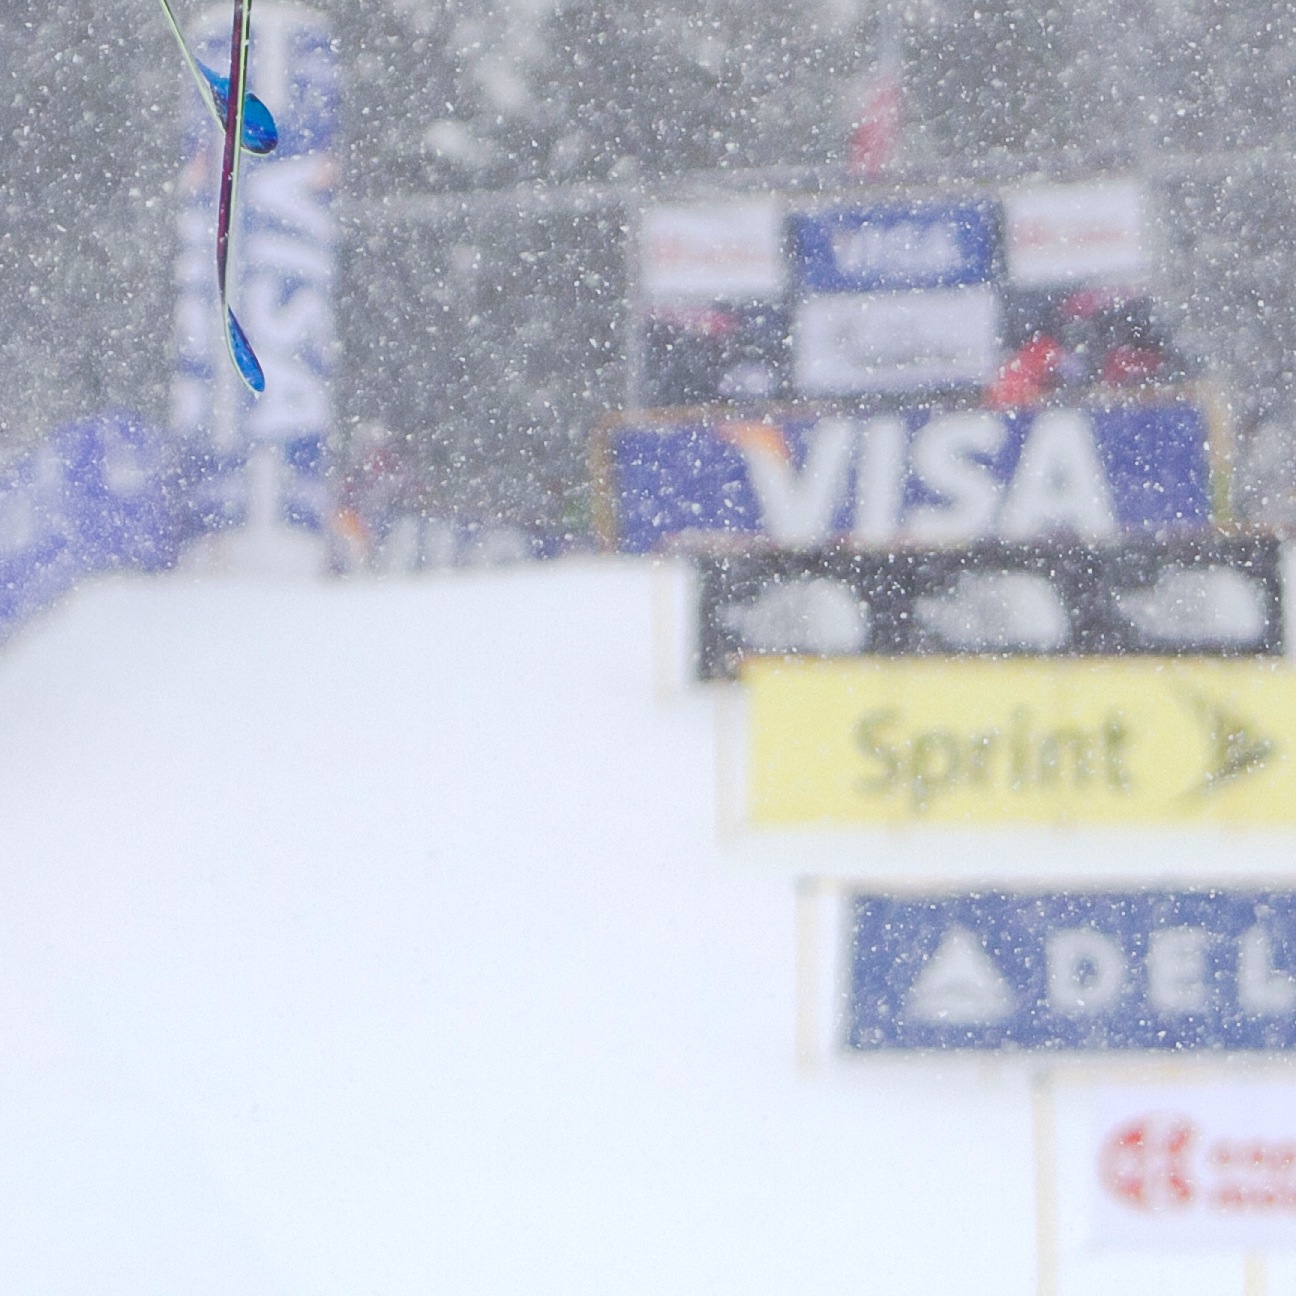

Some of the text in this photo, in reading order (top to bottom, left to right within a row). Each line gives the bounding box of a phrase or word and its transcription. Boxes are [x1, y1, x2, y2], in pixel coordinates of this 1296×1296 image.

[244, 151, 340, 438] VISA
[718, 412, 1114, 547] VISA
[853, 707, 1136, 812] Sprint
